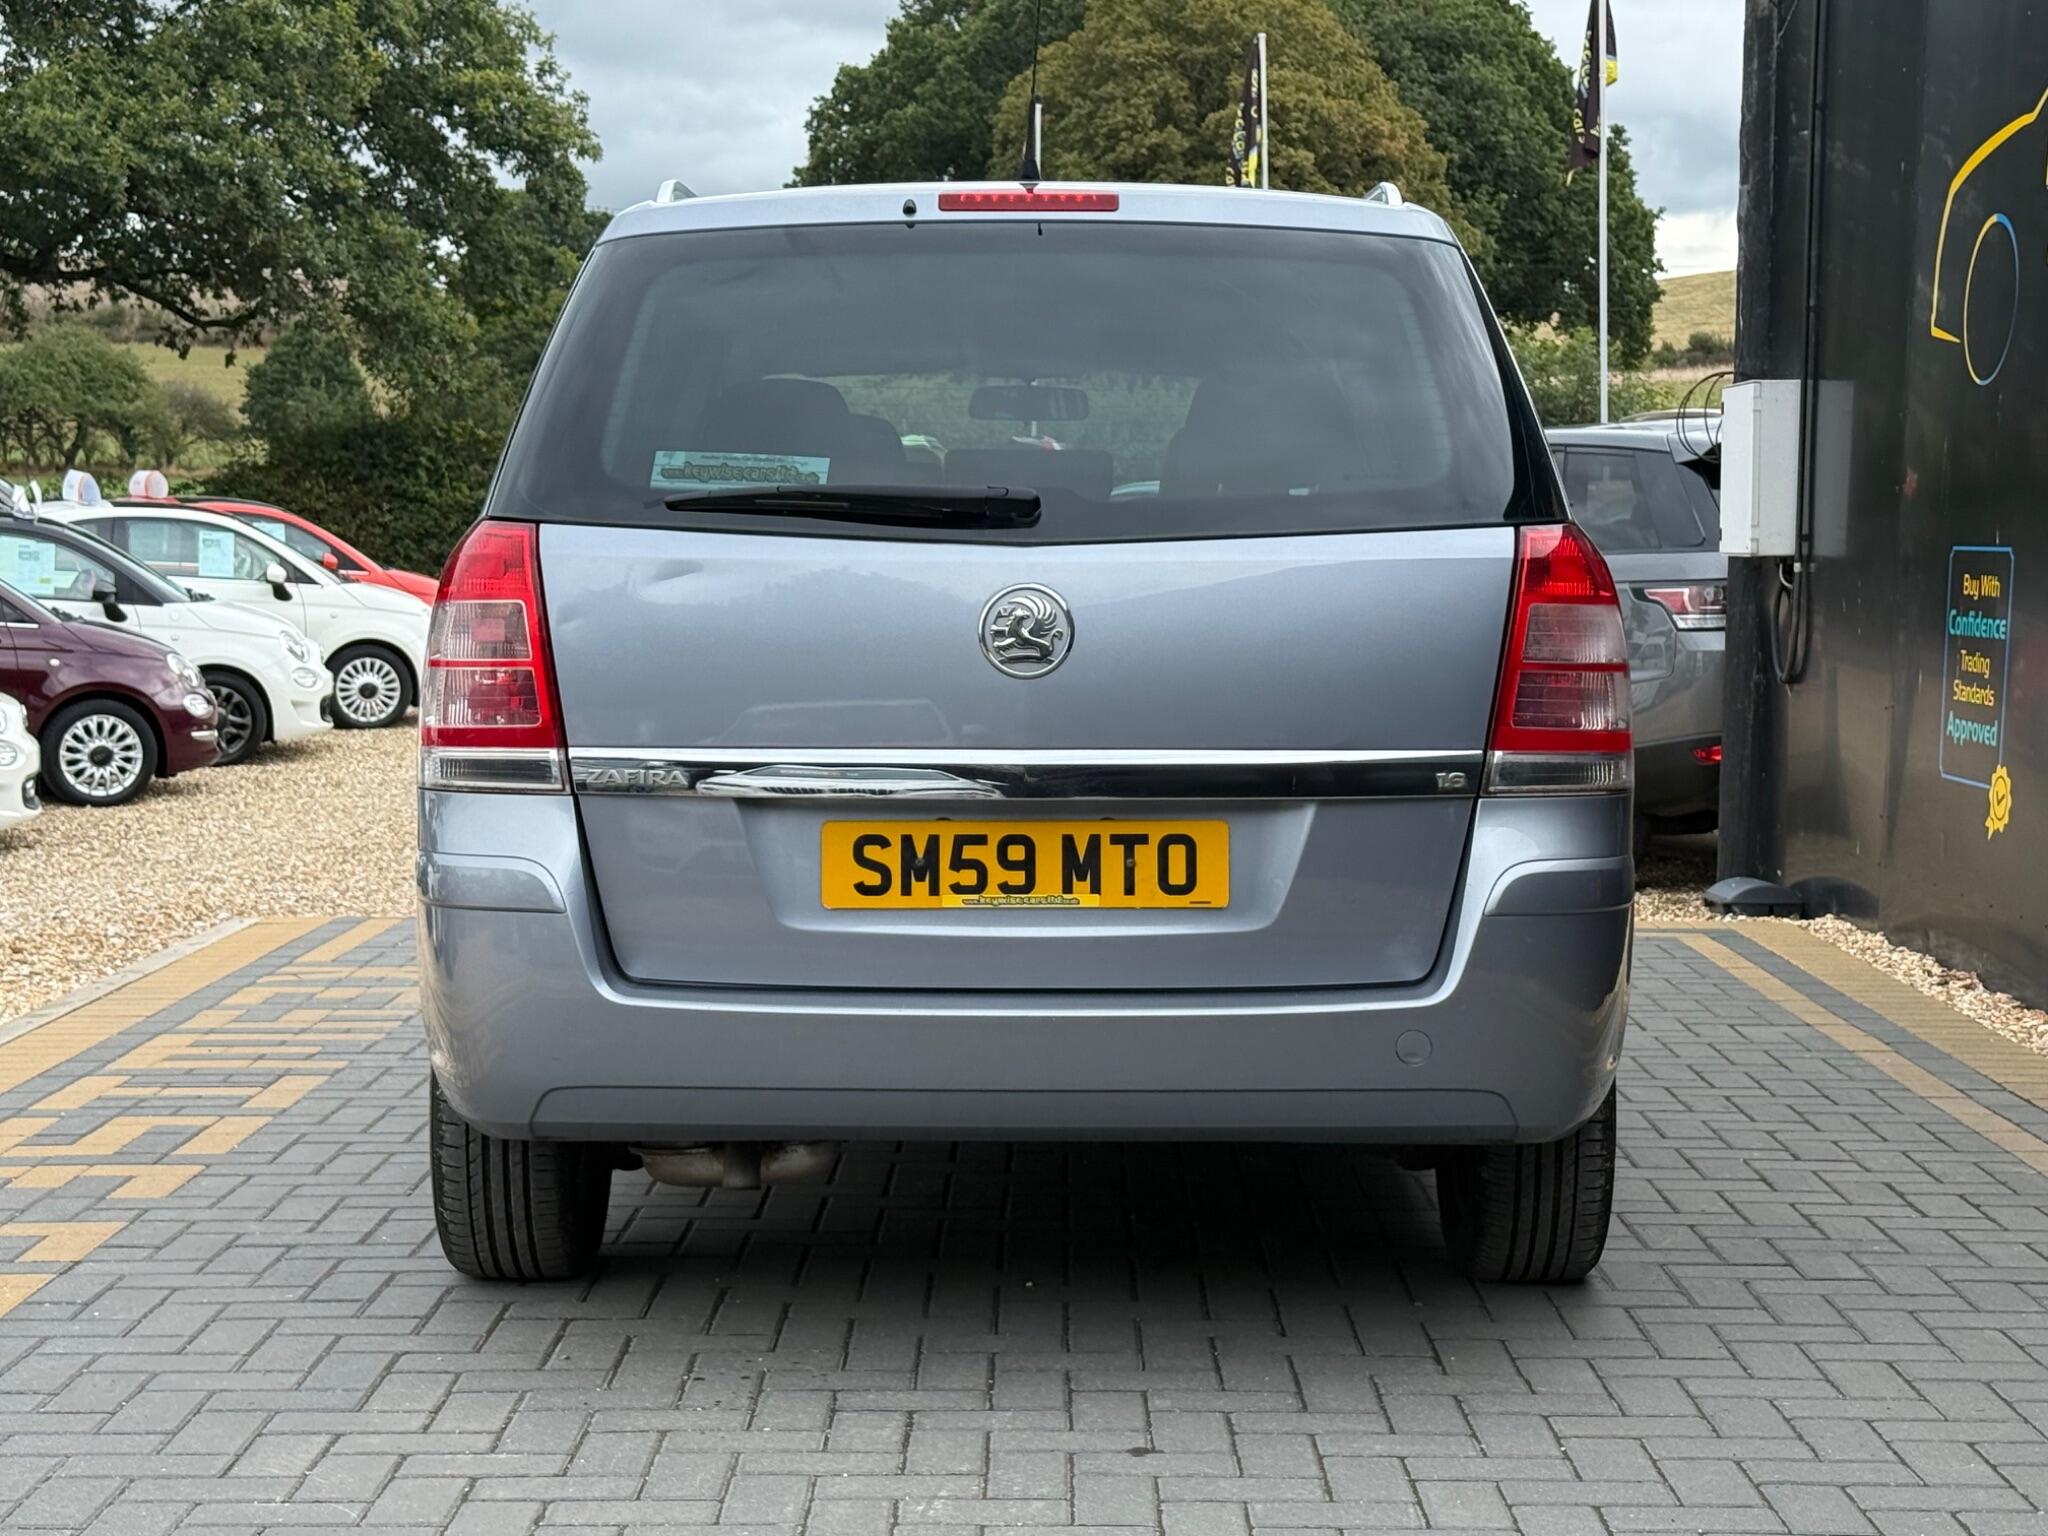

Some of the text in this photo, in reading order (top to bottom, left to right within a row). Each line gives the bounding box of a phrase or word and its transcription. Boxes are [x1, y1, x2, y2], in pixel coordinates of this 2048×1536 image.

[1963, 574, 2001, 600] Buy With
[1949, 608, 2007, 640] Confidence
[1960, 649, 1991, 679] Trading
[1953, 679, 1996, 707] Standards
[1946, 710, 1998, 747] Approved
[586, 768, 689, 786] ZAFIRA
[852, 833, 1198, 897] SM59 MTO
